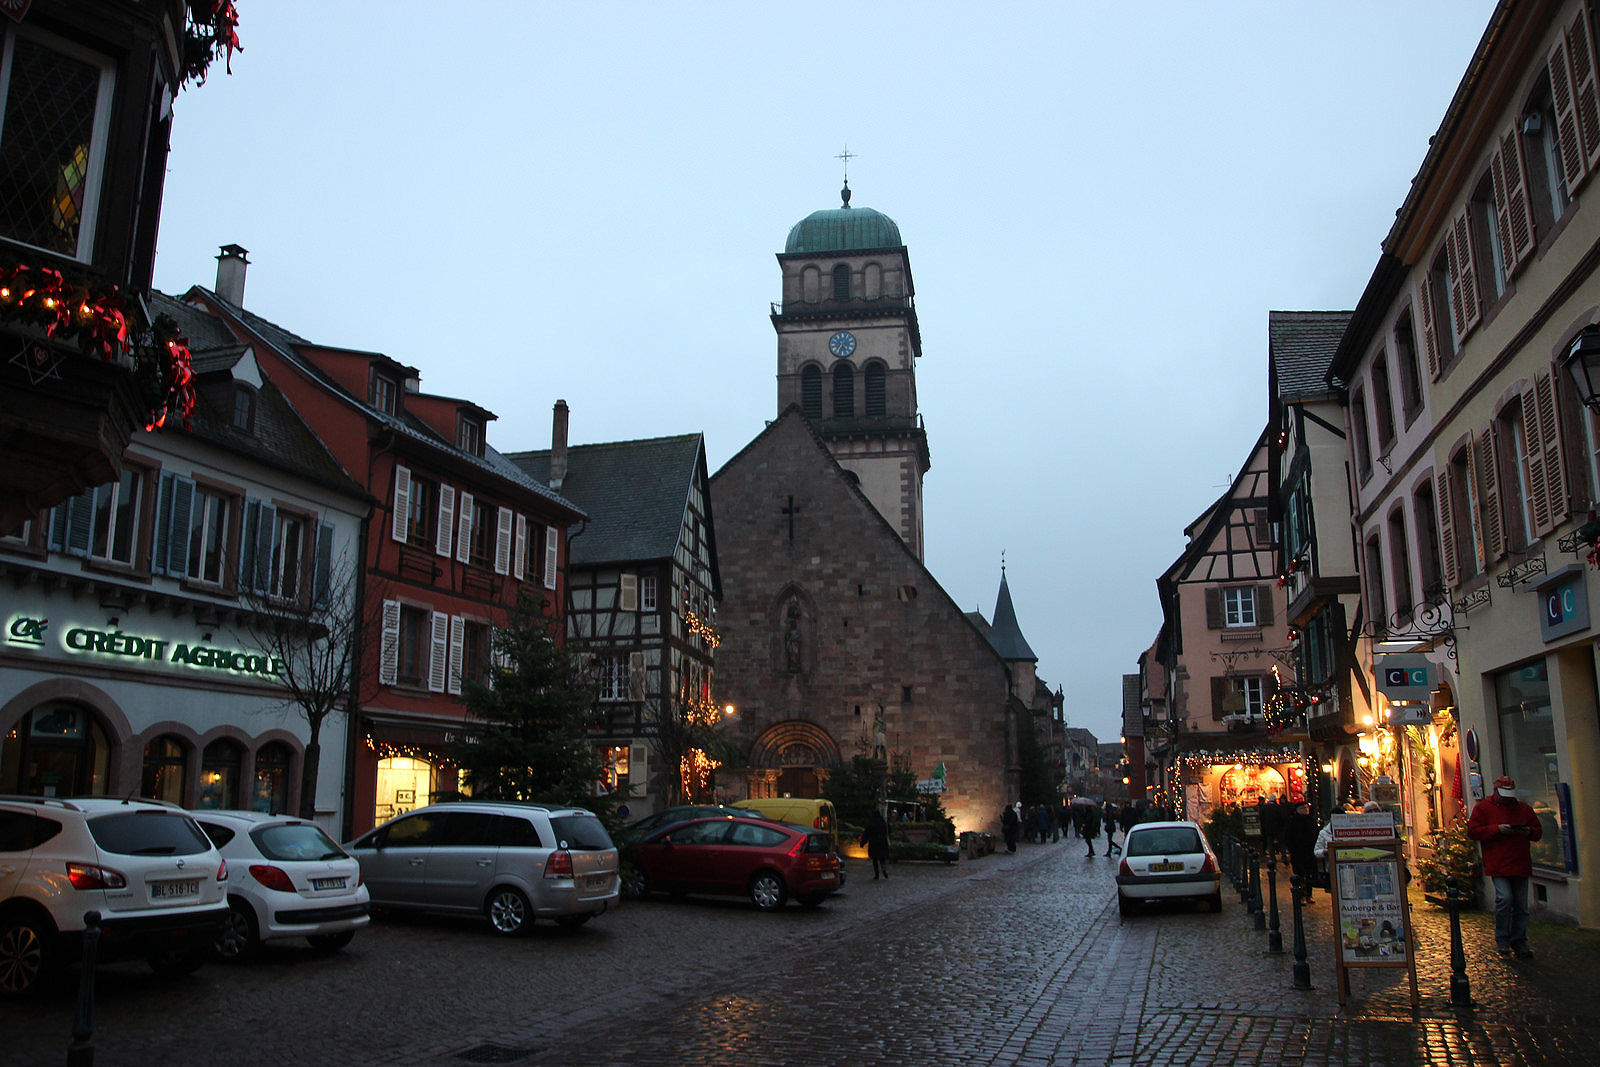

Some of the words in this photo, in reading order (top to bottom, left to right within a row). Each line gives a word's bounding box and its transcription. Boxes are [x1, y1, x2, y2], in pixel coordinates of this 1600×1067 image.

[1549, 588, 1573, 618] CIC
[66, 628, 169, 660] CRÉDIT
[171, 644, 286, 677] AGRICOLE
[1389, 670, 1424, 685] CIC
[1335, 829, 1360, 837] Terrasse
[1341, 904, 1377, 913] Auberge
[1378, 904, 1385, 912] &
[1386, 903, 1400, 912] Bar
